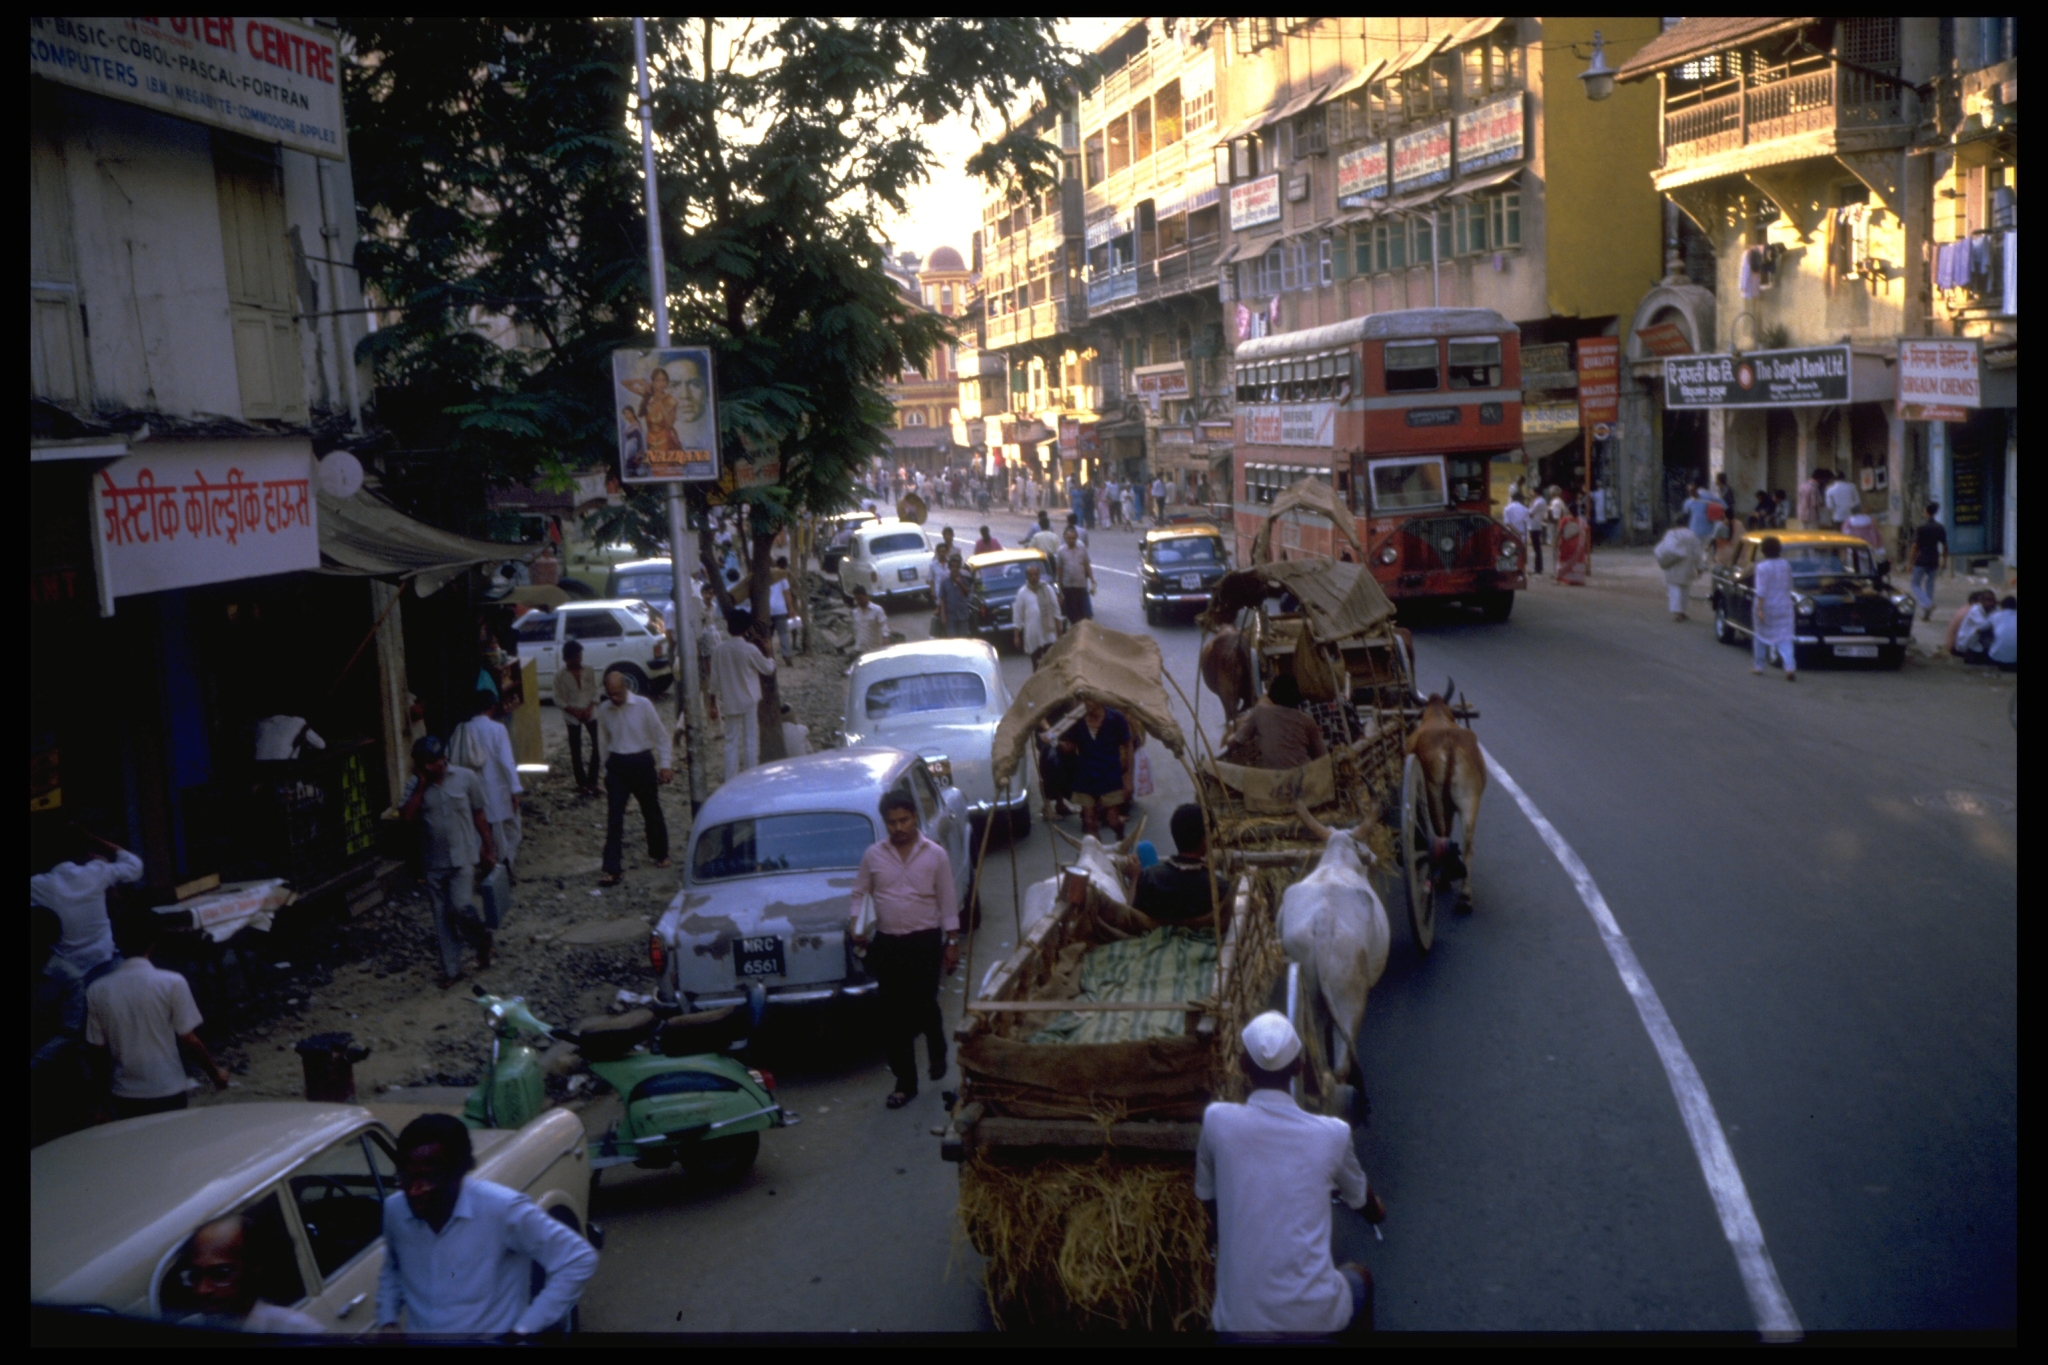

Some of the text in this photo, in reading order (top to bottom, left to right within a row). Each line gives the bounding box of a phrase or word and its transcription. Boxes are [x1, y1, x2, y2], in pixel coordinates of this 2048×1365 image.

[246, 19, 335, 84] CENTRE
[1583, 356, 1616, 369] QUALITY
[1755, 360, 1772, 381] The
[1773, 358, 1801, 384] Sangli
[1802, 356, 1826, 378] Bank
[1940, 377, 1979, 397] CHEMIST
[644, 449, 711, 466] NAZRANA
[262, 479, 311, 535] हाऊस
[743, 958, 777, 975] 6561
